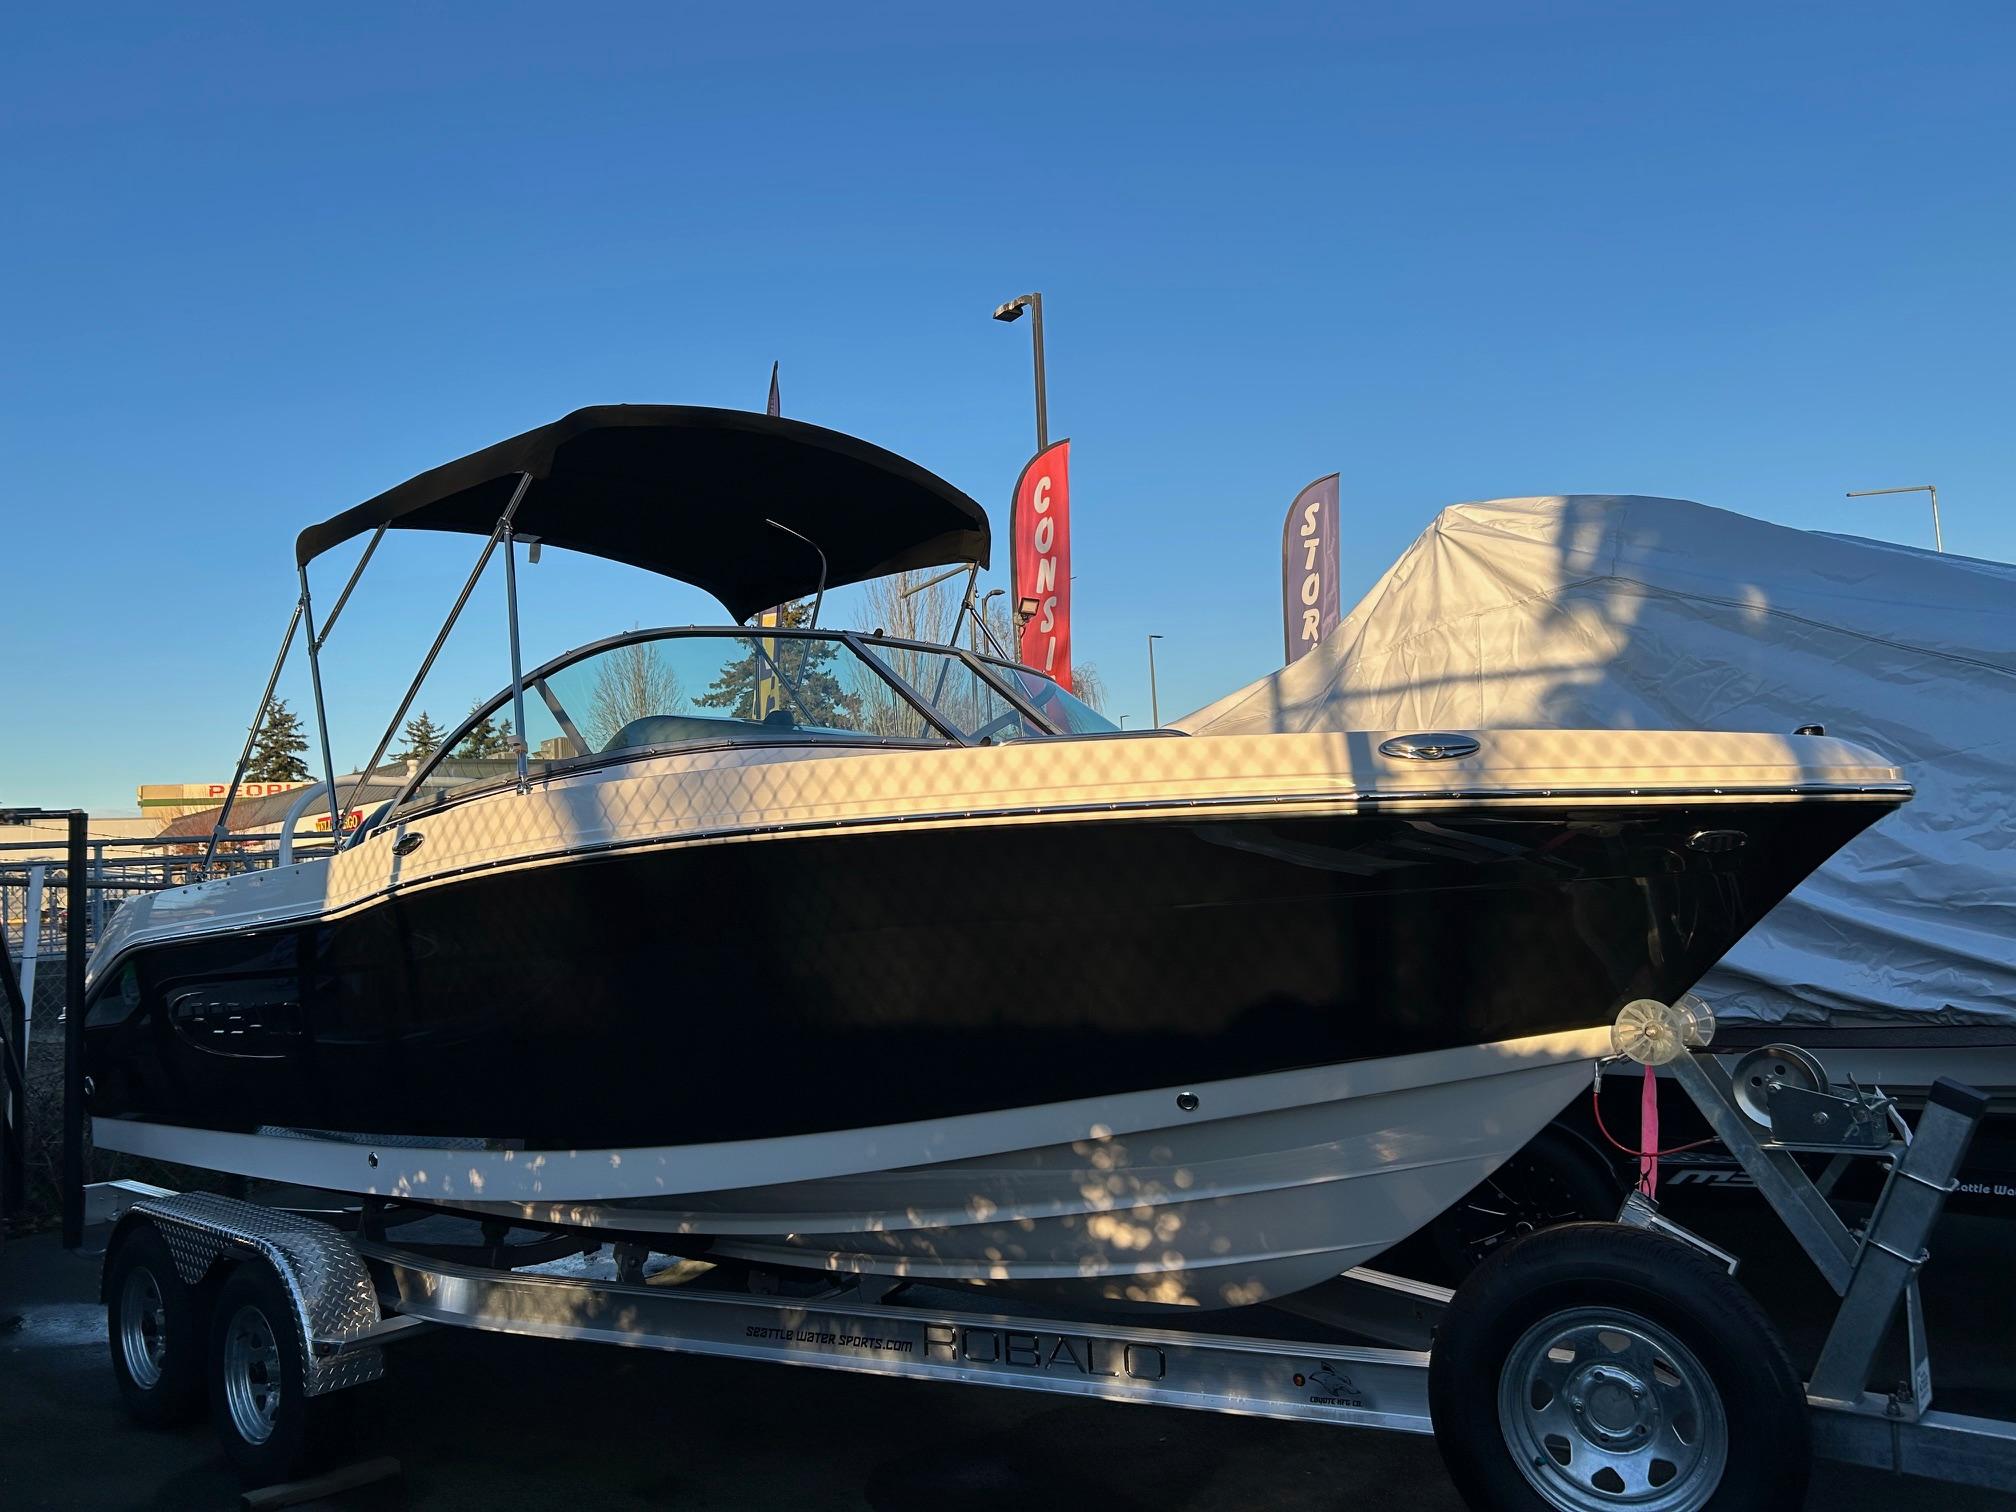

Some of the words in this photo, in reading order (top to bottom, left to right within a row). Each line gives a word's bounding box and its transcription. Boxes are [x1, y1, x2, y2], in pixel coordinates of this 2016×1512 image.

[1033, 475, 1057, 682] CONSI
[1300, 502, 1320, 651] STOR
[1993, 1184, 2016, 1196] Wa
[923, 1323, 1166, 1381] ROBALO
